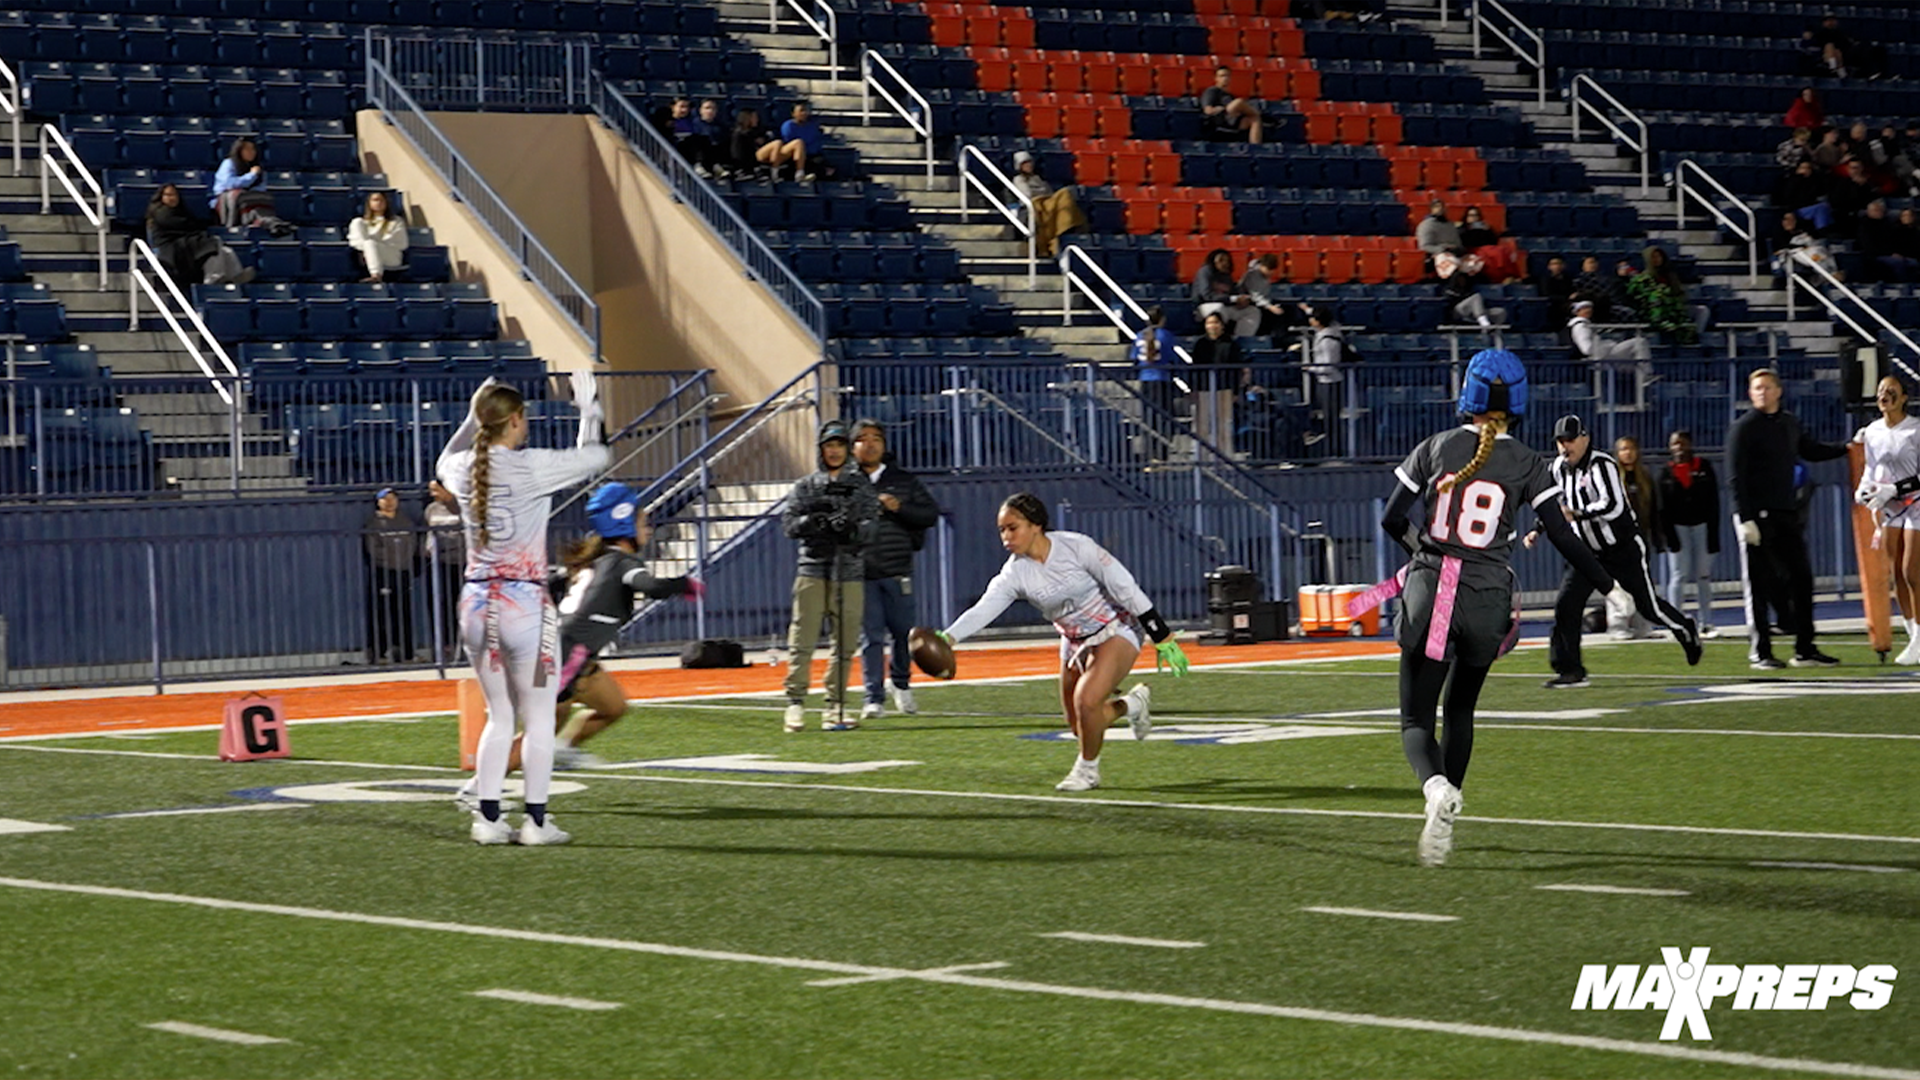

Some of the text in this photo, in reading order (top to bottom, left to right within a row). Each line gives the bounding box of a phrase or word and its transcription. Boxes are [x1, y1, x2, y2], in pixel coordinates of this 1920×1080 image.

[1856, 347, 1877, 398] 1
[1430, 472, 1507, 549] 18
[241, 705, 280, 754] G
